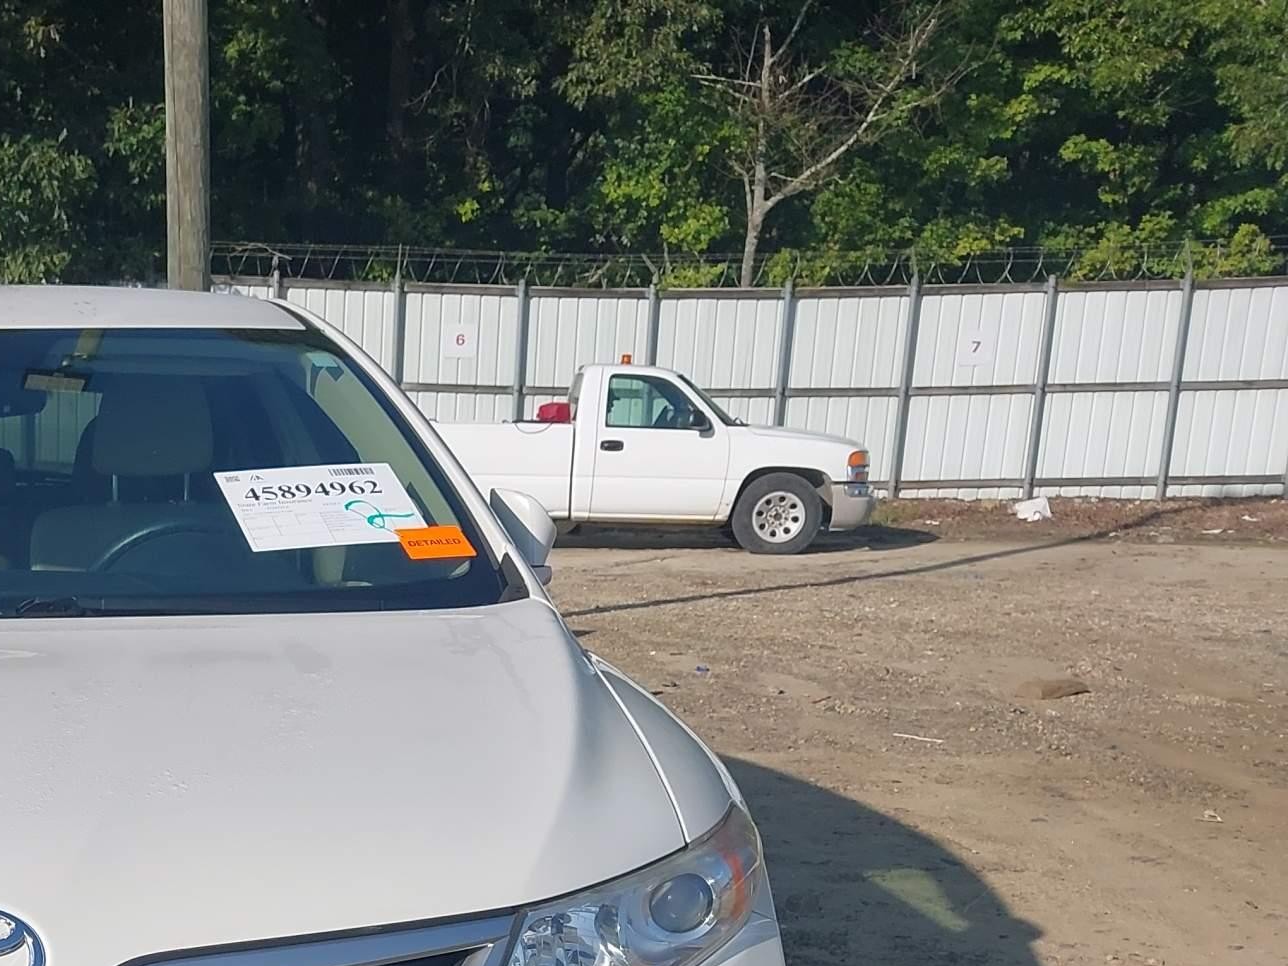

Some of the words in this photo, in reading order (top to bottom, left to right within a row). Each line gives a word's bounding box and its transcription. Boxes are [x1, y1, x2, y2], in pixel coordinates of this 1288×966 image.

[455, 333, 466, 346] 6
[971, 340, 982, 353] 7
[244, 480, 383, 502] 45894962
[407, 537, 462, 548] DETAILED
